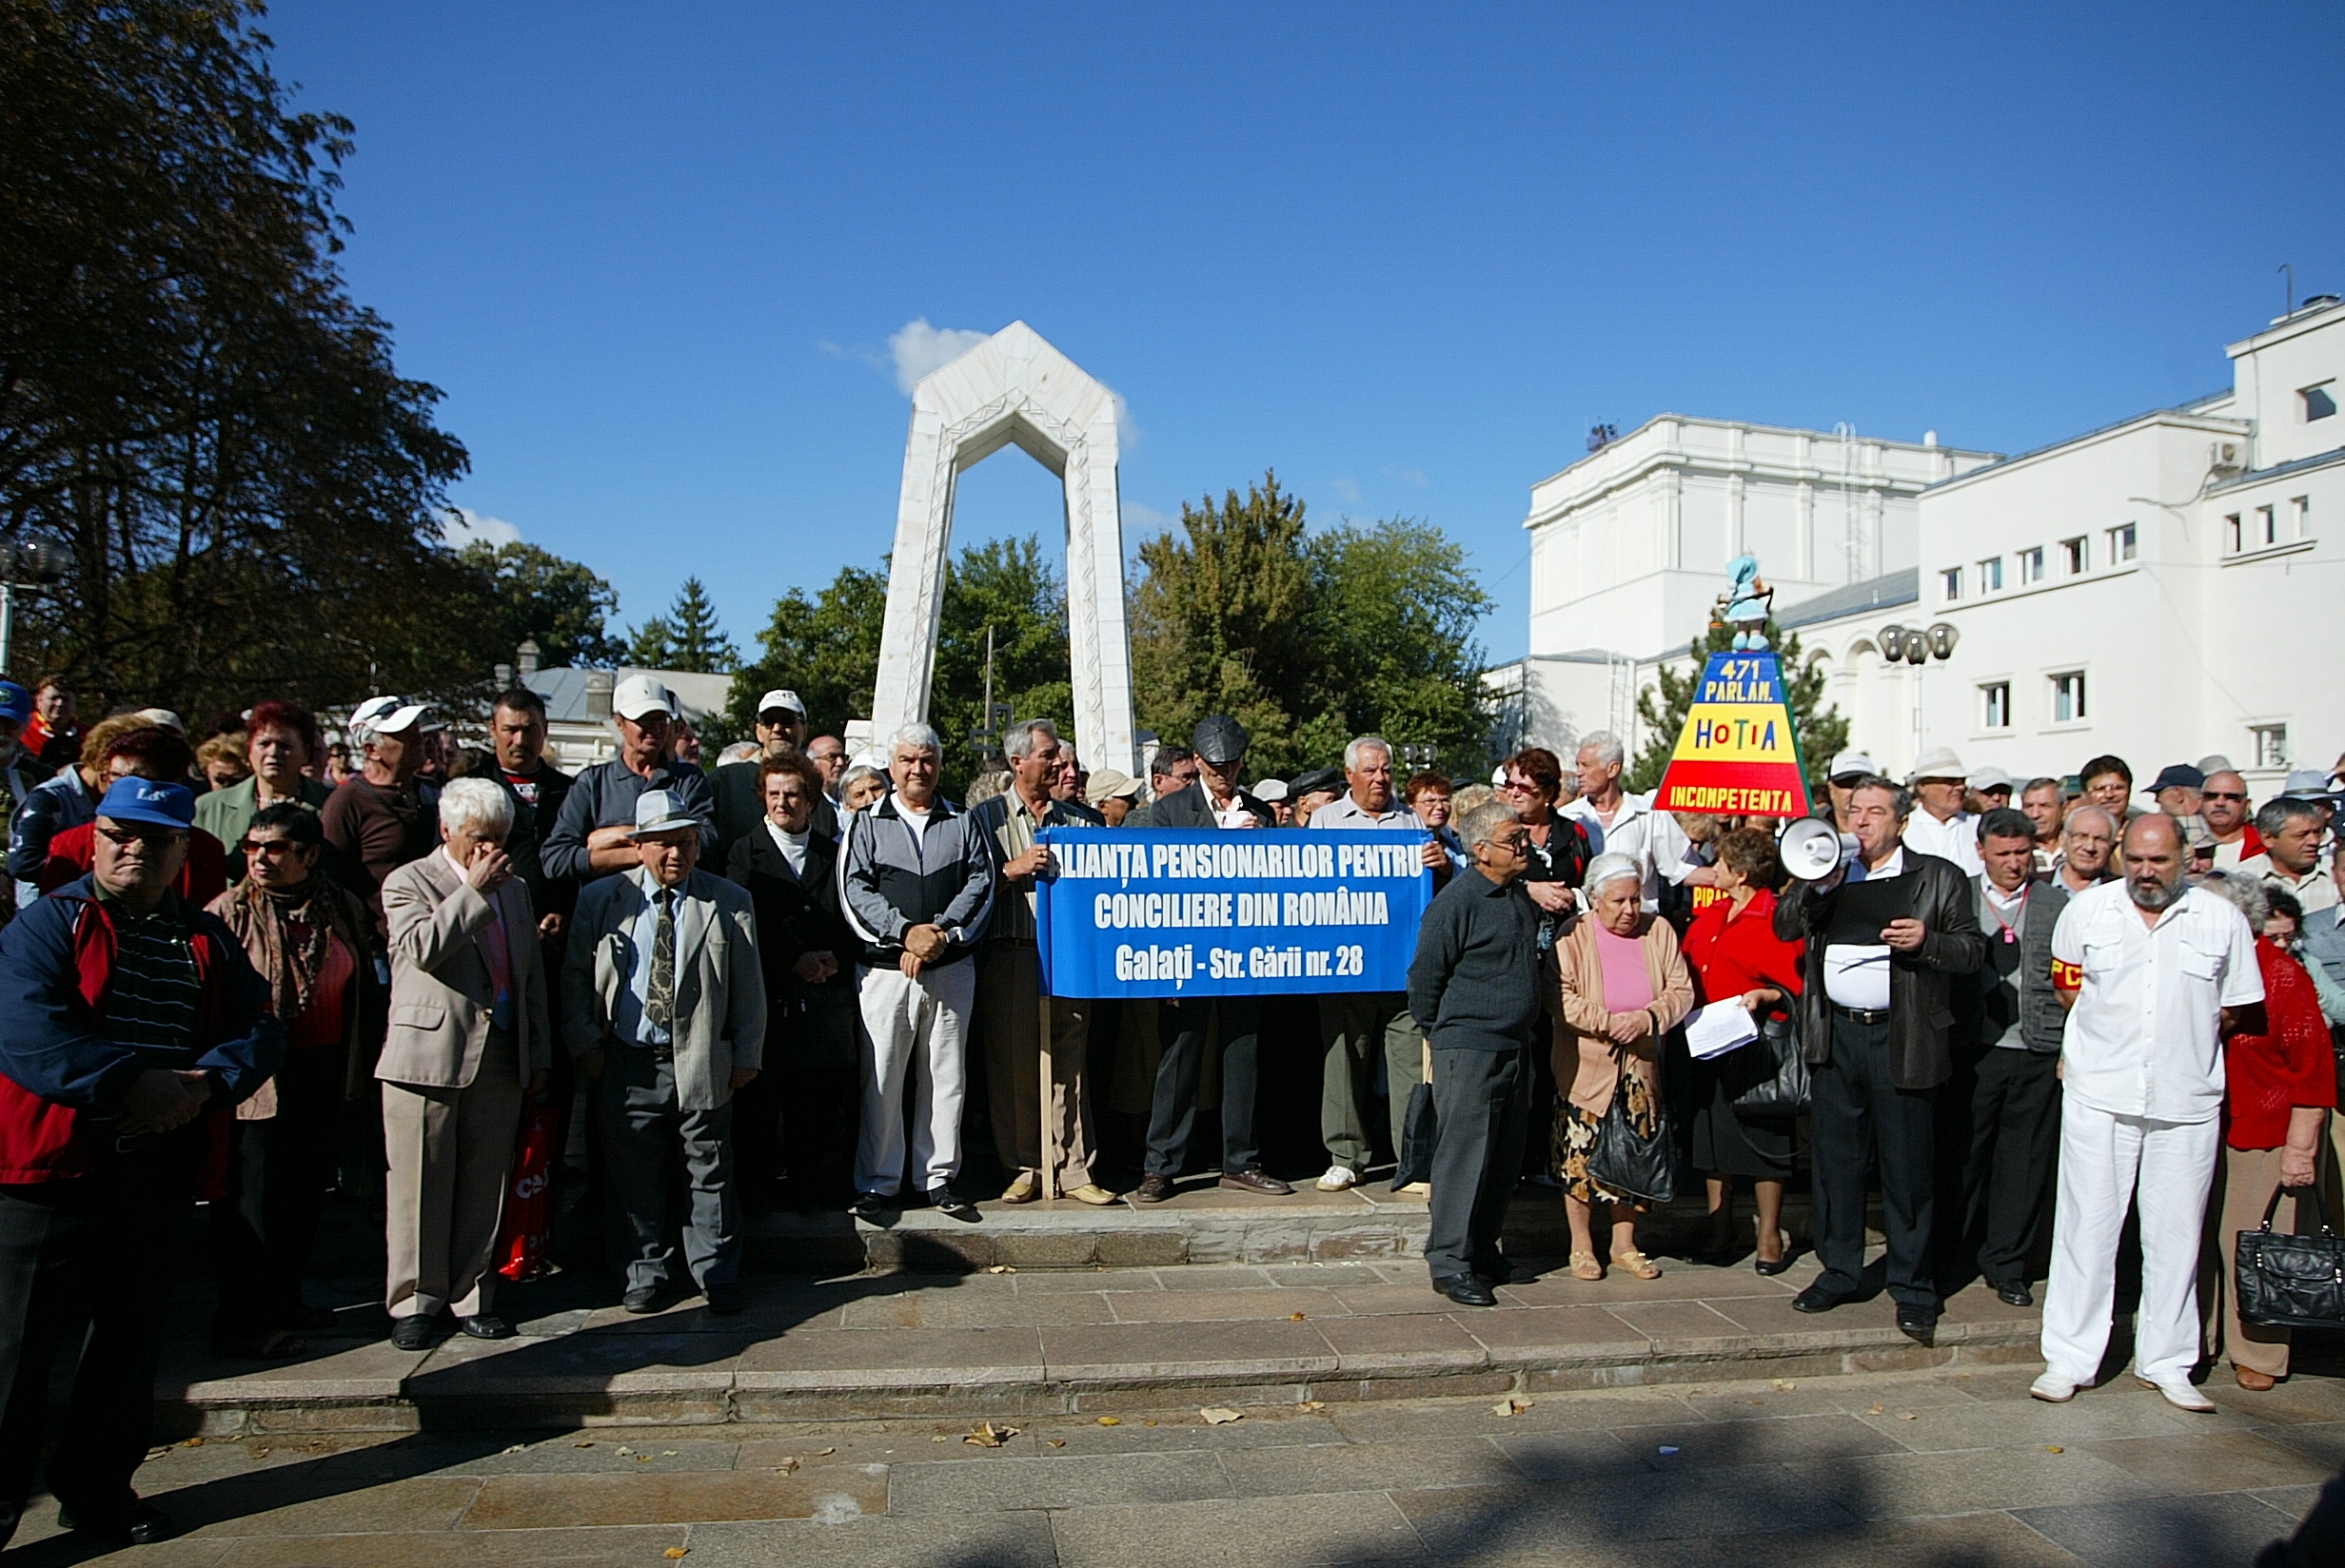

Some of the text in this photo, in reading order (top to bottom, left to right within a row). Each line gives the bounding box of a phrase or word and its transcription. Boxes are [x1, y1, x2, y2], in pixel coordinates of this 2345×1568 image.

[1720, 659, 1761, 680] 471
[1705, 680, 1774, 702] PARLAM.
[1695, 718, 1776, 751] HOTIA
[1669, 786, 1793, 813] INCOMPETENTA
[1153, 843, 1334, 879] PENSIONARILOR
[1338, 844, 1424, 878] PENTRU
[1094, 885, 1389, 929] CONCILIERE DIN ROMÂNIA
[1115, 944, 1192, 990] Galați
[1210, 948, 1246, 979] Str.
[1249, 945, 1302, 978] Gării
[1305, 951, 1332, 977] nr.
[1335, 945, 1364, 976] 28
